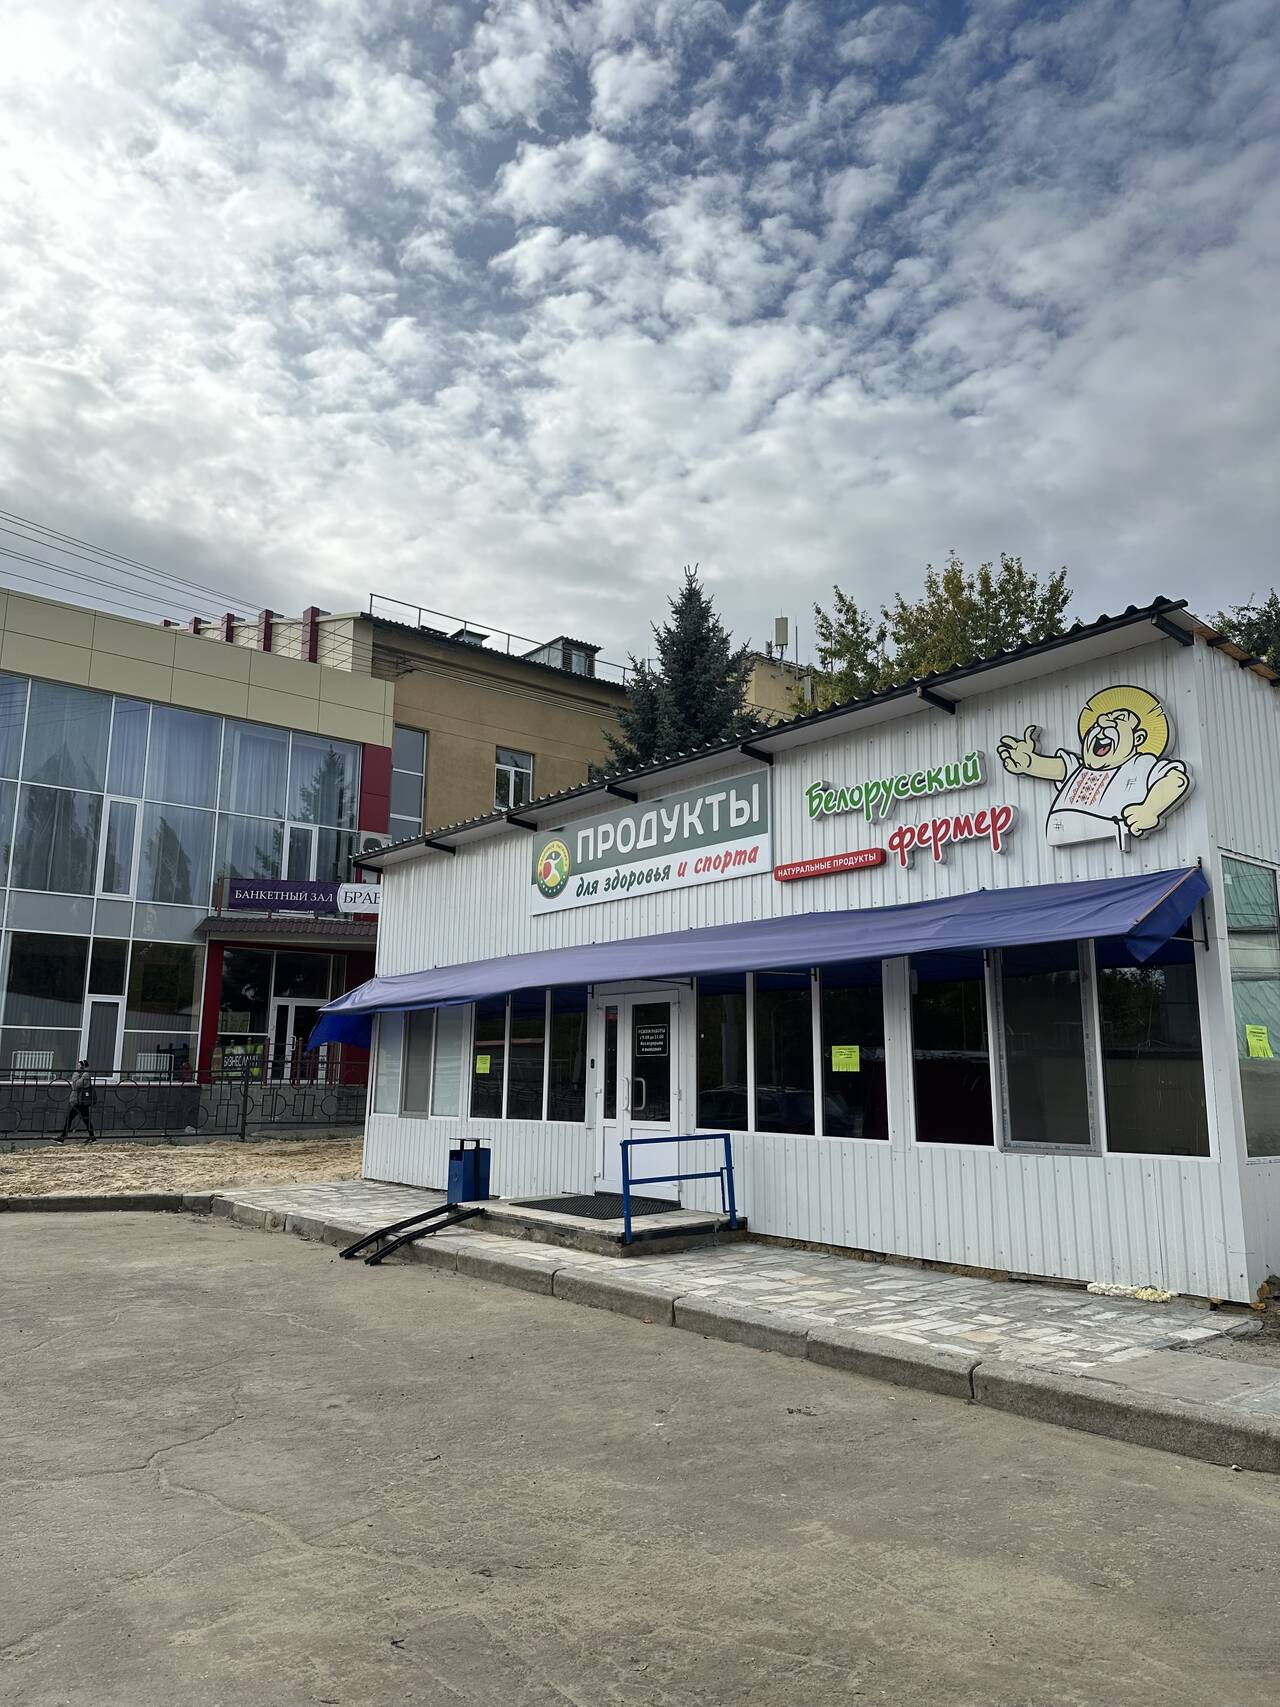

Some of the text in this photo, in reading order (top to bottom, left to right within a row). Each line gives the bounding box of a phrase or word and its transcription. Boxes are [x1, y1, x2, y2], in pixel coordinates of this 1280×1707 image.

[804, 751, 981, 822] Белорусский
[576, 783, 759, 864] ПРОДУКТЫ
[888, 804, 1012, 867] фермер
[576, 845, 760, 897] для здоровья и спорта
[778, 852, 877, 878] НАТУРАЛЬНЫЕ ПРОДУКТЫ
[234, 889, 333, 902] БАНКЕТНЫЙ ЗАЛ
